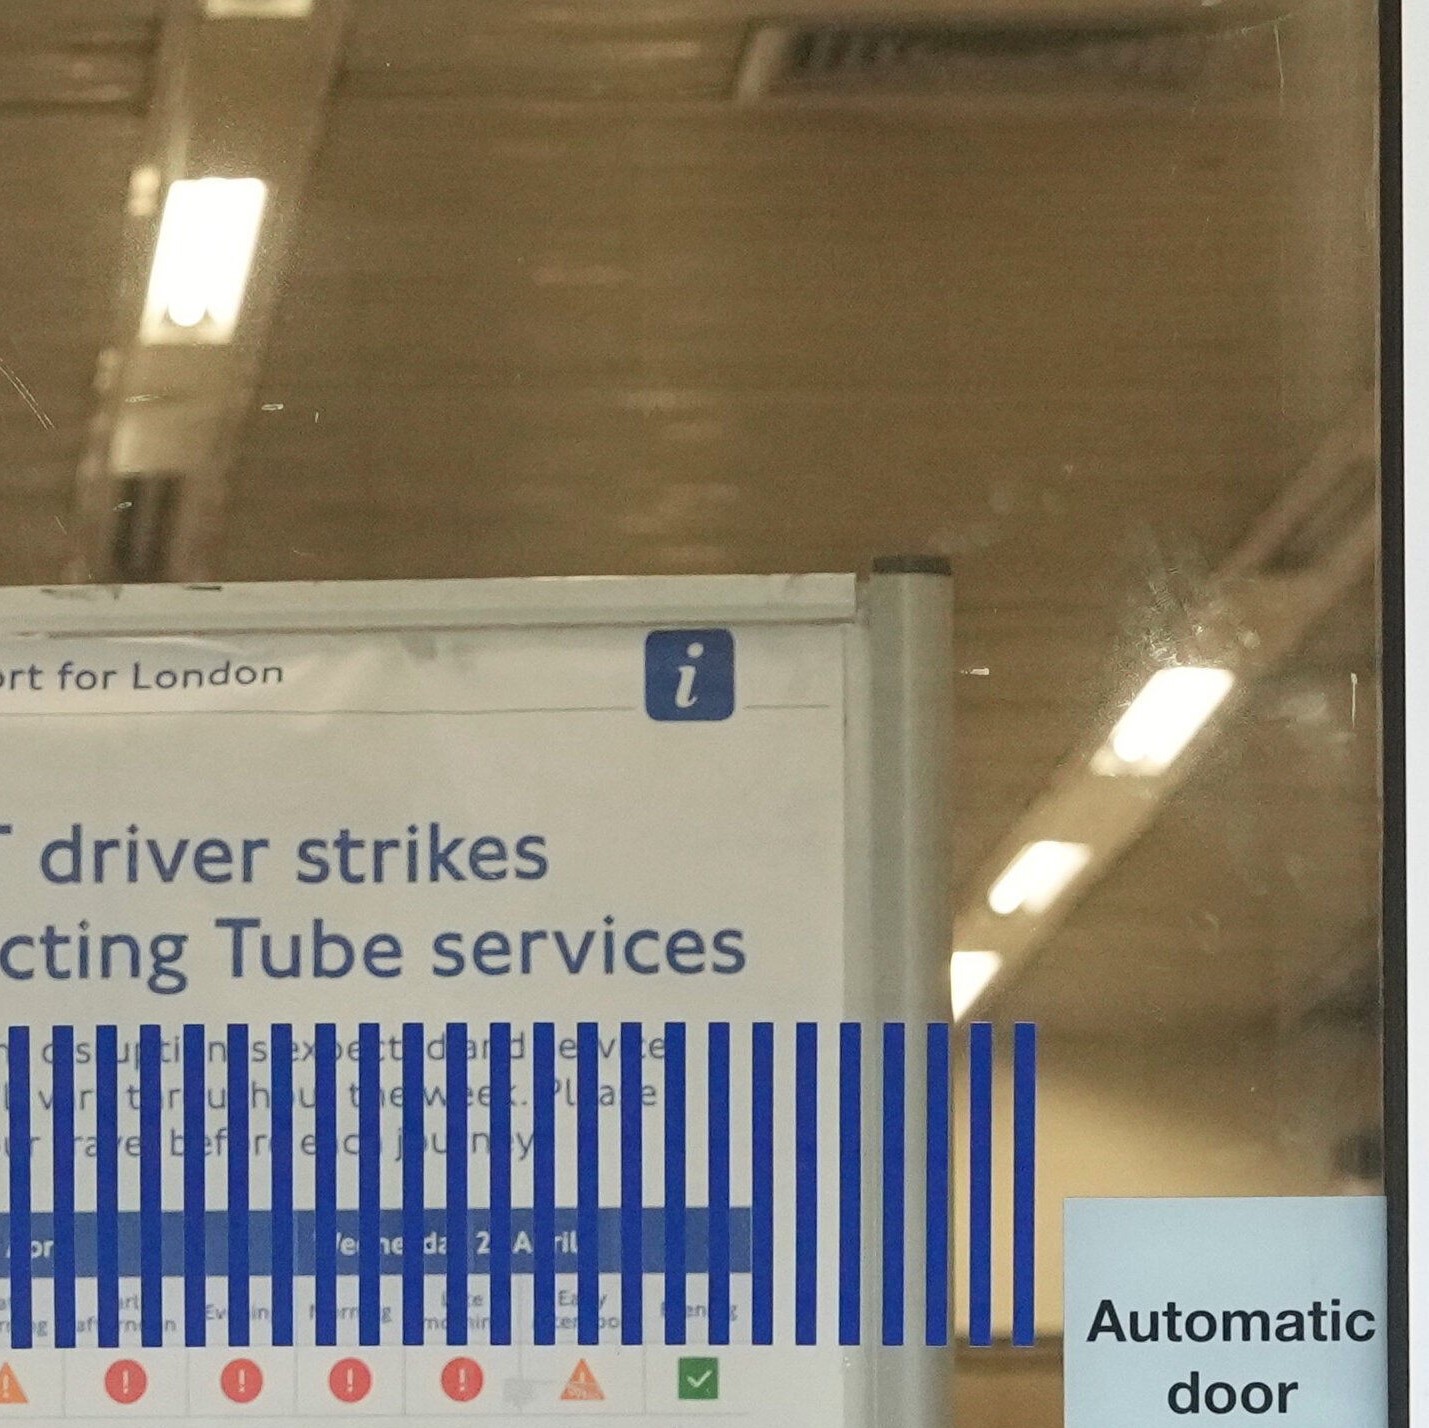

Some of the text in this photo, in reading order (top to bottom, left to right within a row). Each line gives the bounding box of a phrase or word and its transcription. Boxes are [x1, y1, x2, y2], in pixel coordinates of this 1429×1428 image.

[57, 660, 118, 690] for
[133, 659, 282, 689] London
[40, 823, 269, 884] driver
[297, 822, 548, 884] strikes
[215, 918, 402, 979] Tube
[433, 915, 746, 977] services
[1087, 1299, 1376, 1342] Automatic
[1168, 1371, 1298, 1414] door
